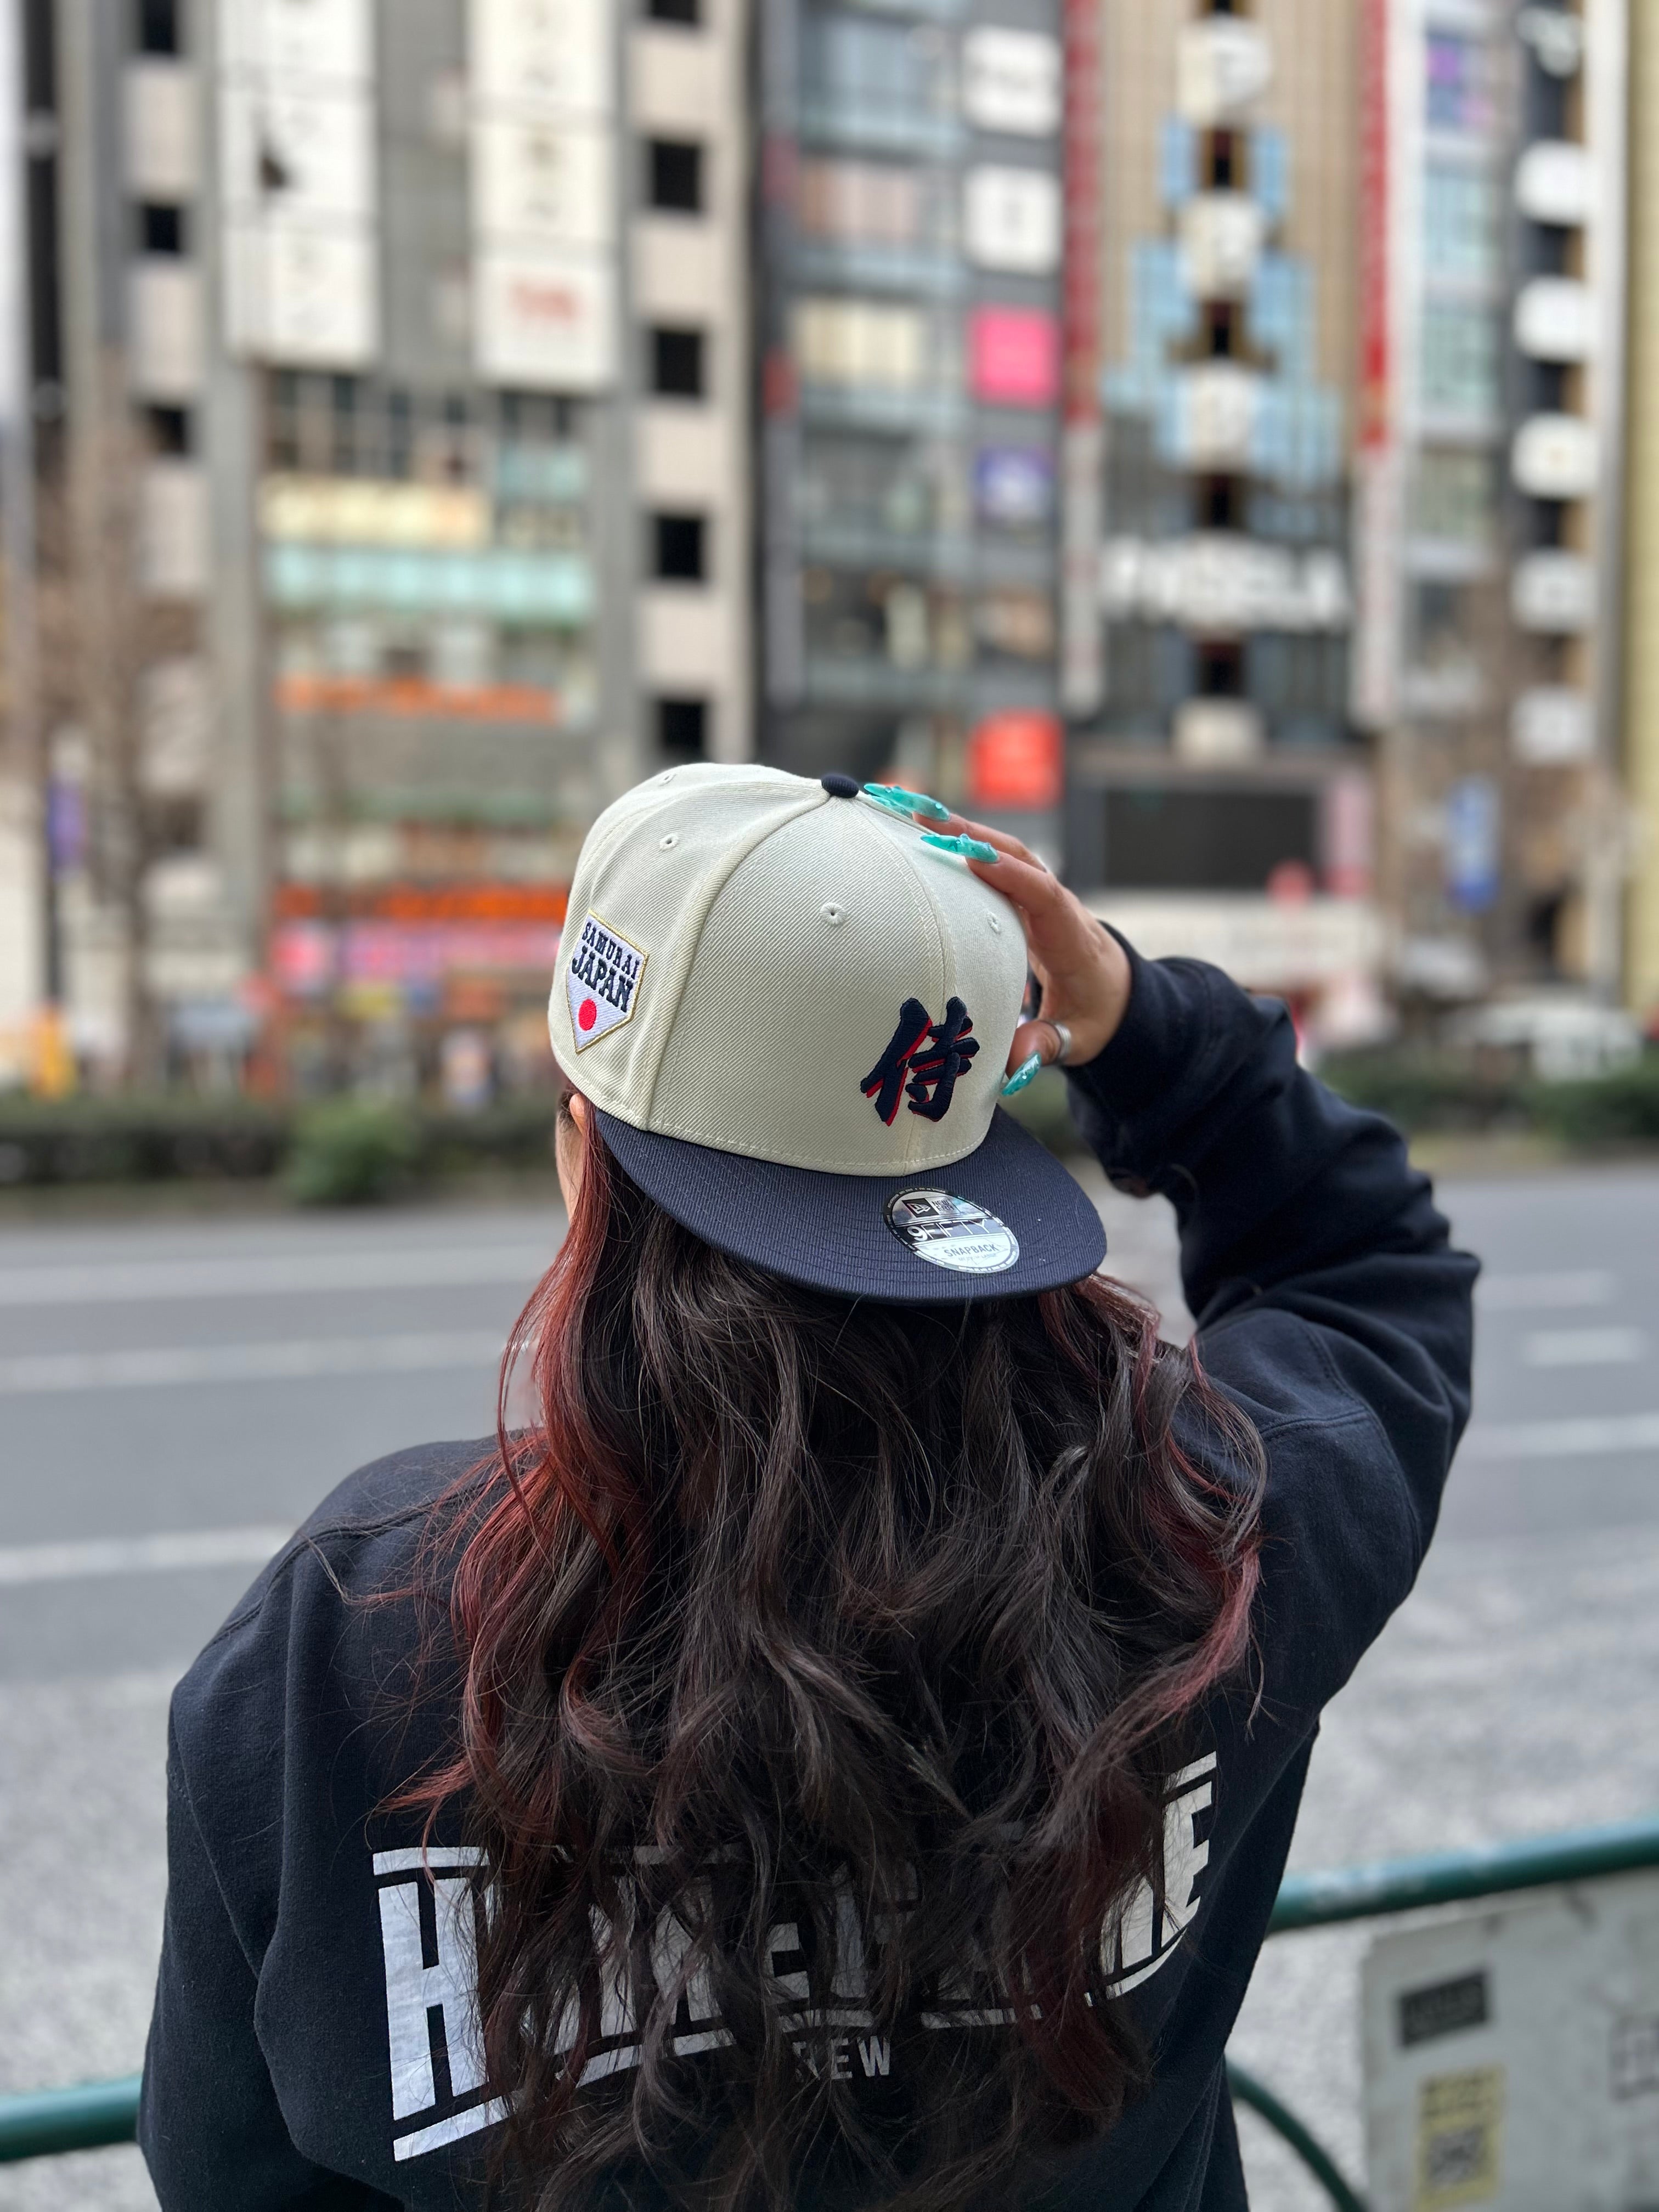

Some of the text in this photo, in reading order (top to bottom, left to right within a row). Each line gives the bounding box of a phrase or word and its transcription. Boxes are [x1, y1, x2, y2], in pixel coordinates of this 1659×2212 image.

[572, 946, 633, 1013] JAPAN
[582, 922, 640, 979] SAMURAI
[860, 996, 980, 1127] 侍
[944, 1244, 999, 1257] SNAPBACK
